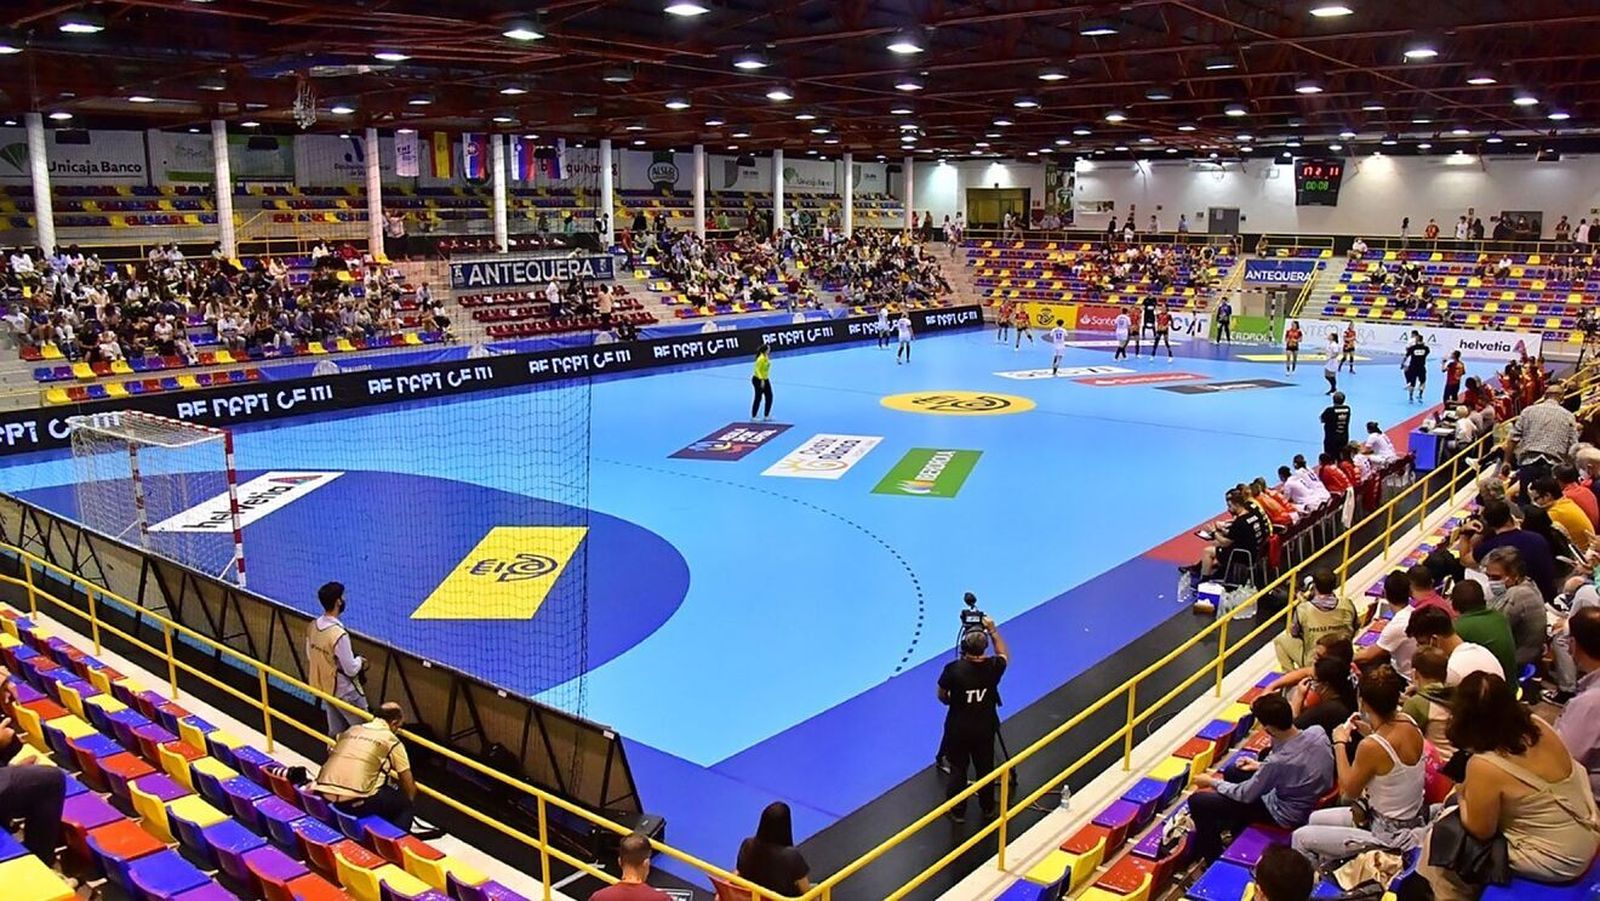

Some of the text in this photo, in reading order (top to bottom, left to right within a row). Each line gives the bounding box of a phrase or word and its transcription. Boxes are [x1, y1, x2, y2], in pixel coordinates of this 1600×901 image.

[48, 160, 142, 174] Unicaja Banco
[469, 259, 596, 286] ANTEQUERA
[1245, 271, 1312, 282] ANTEQUERA
[1460, 339, 1511, 352] helvetia
[965, 687, 987, 703] TV
